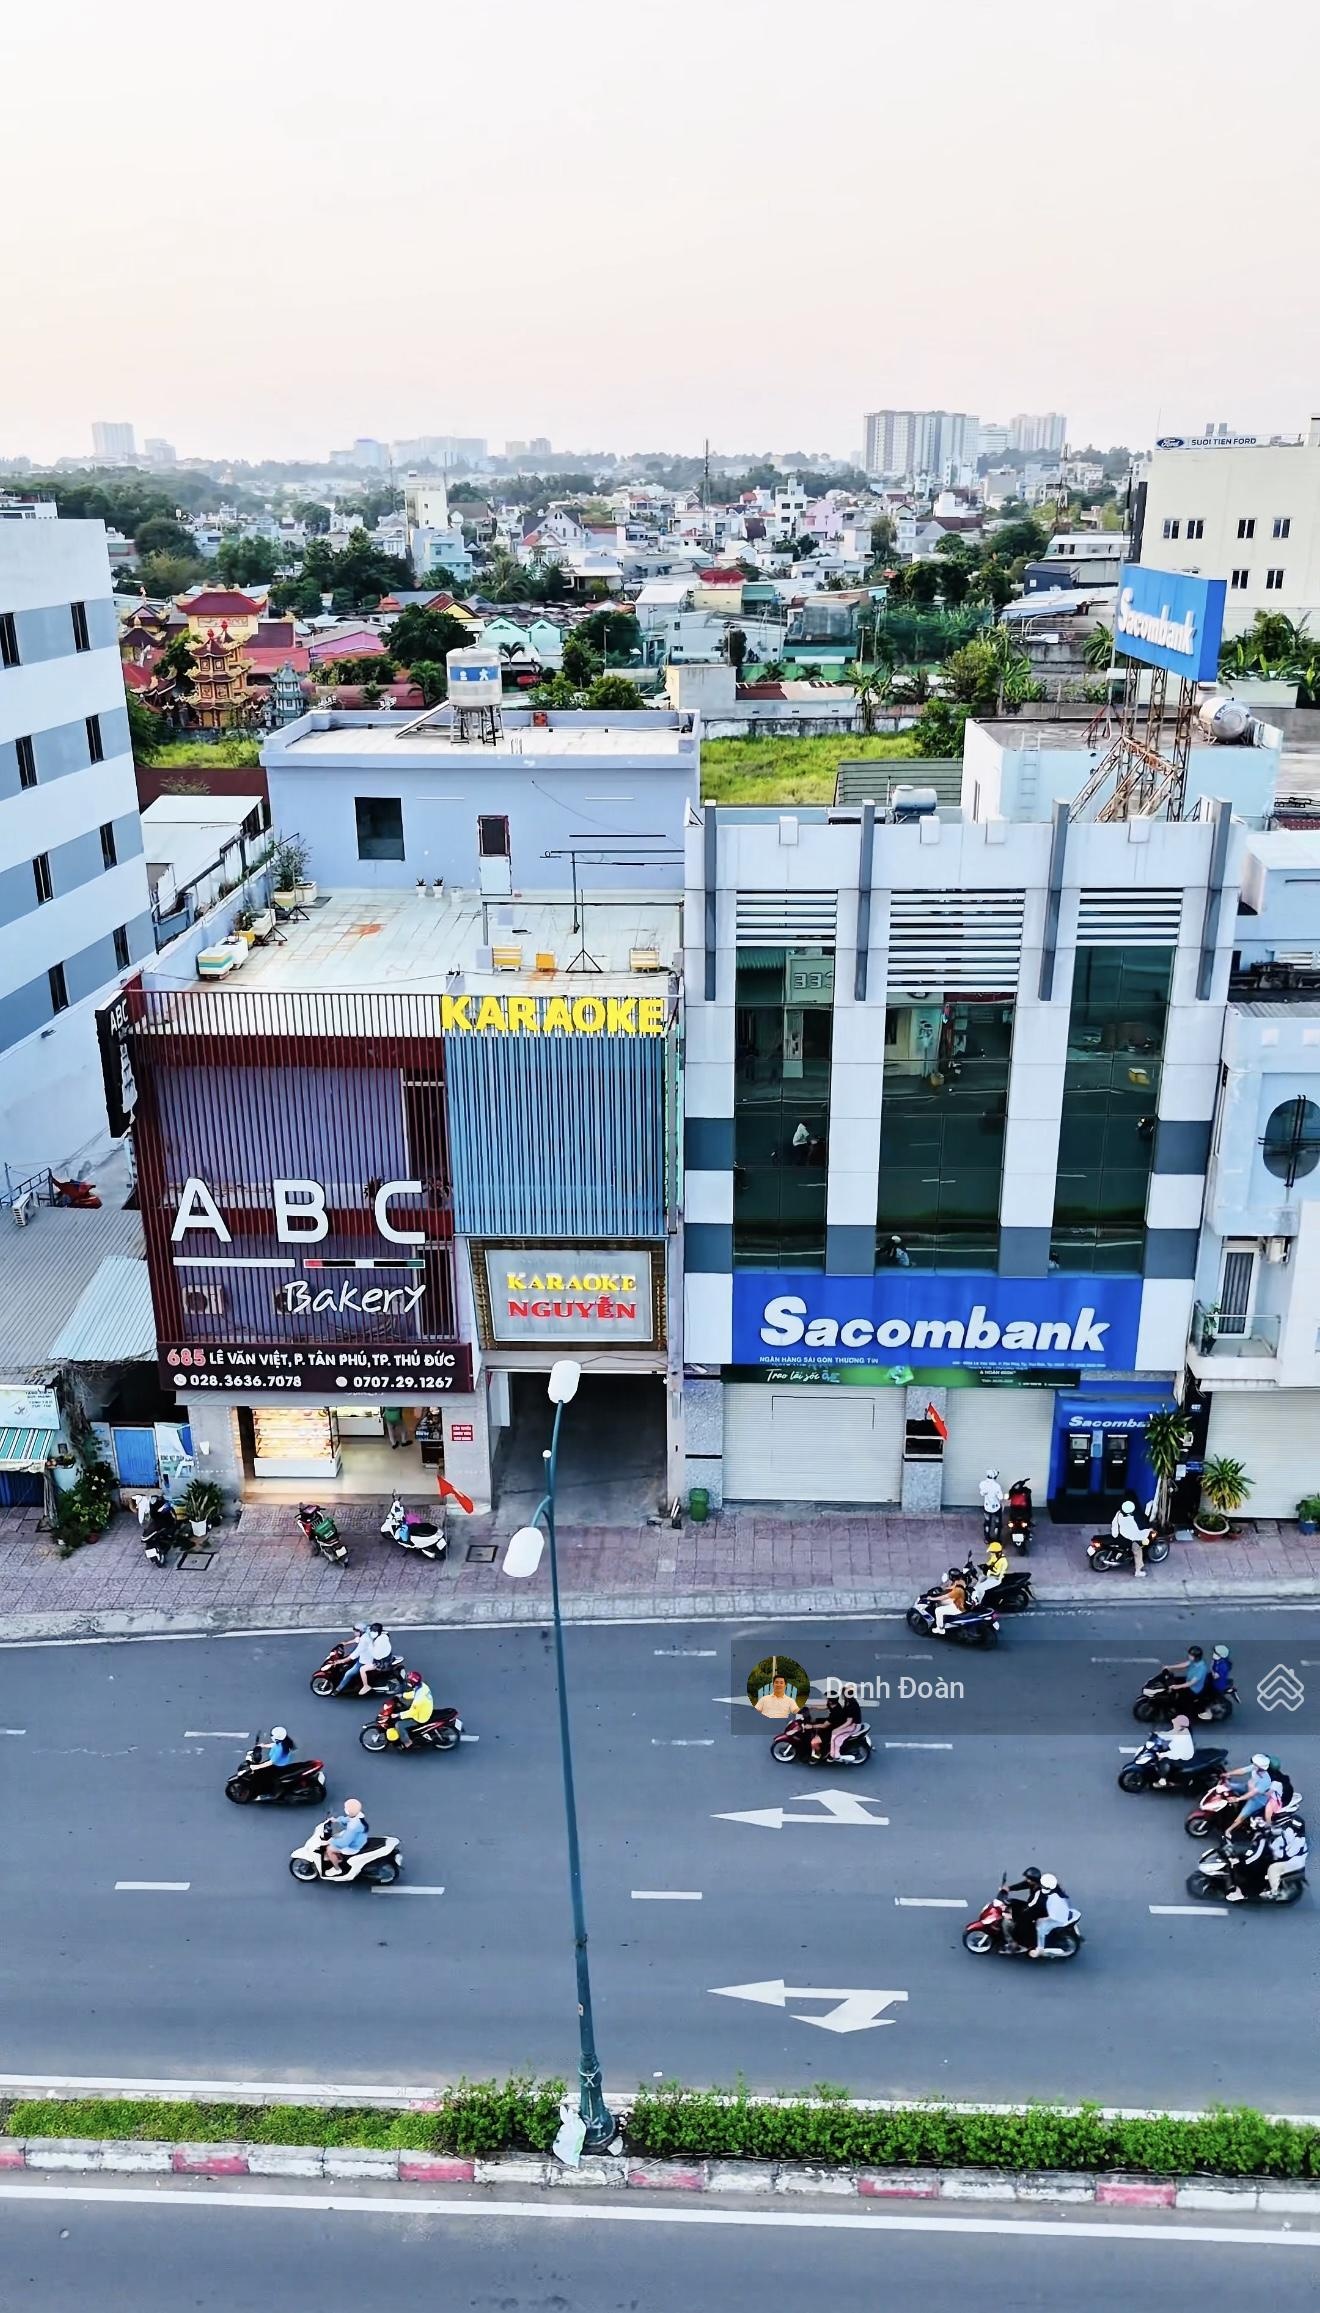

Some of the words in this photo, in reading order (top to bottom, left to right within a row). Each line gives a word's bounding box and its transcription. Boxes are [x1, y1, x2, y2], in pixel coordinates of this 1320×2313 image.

[1233, 437, 1257, 445] FORD
[1118, 587, 1196, 656] Sacombank
[110, 998, 129, 1036] ABC
[442, 995, 664, 1033] KARAOKE
[507, 1272, 637, 1291] KARAOKE
[284, 1280, 427, 1313] Bakery
[507, 1295, 637, 1320] NGUYỄN
[760, 1295, 1111, 1352] Sacombank
[167, 1348, 206, 1367] 685
[209, 1349, 224, 1365] LÊ
[227, 1350, 256, 1365] VĂN
[258, 1349, 292, 1369] VIỆT,
[294, 1353, 306, 1366] P.
[307, 1349, 336, 1366] TÂN
[394, 1349, 420, 1367] THỦ
[423, 1349, 456, 1367] ĐỨC
[190, 1374, 302, 1387] 028.3636.7078
[353, 1375, 453, 1389] 0707.29.1267
